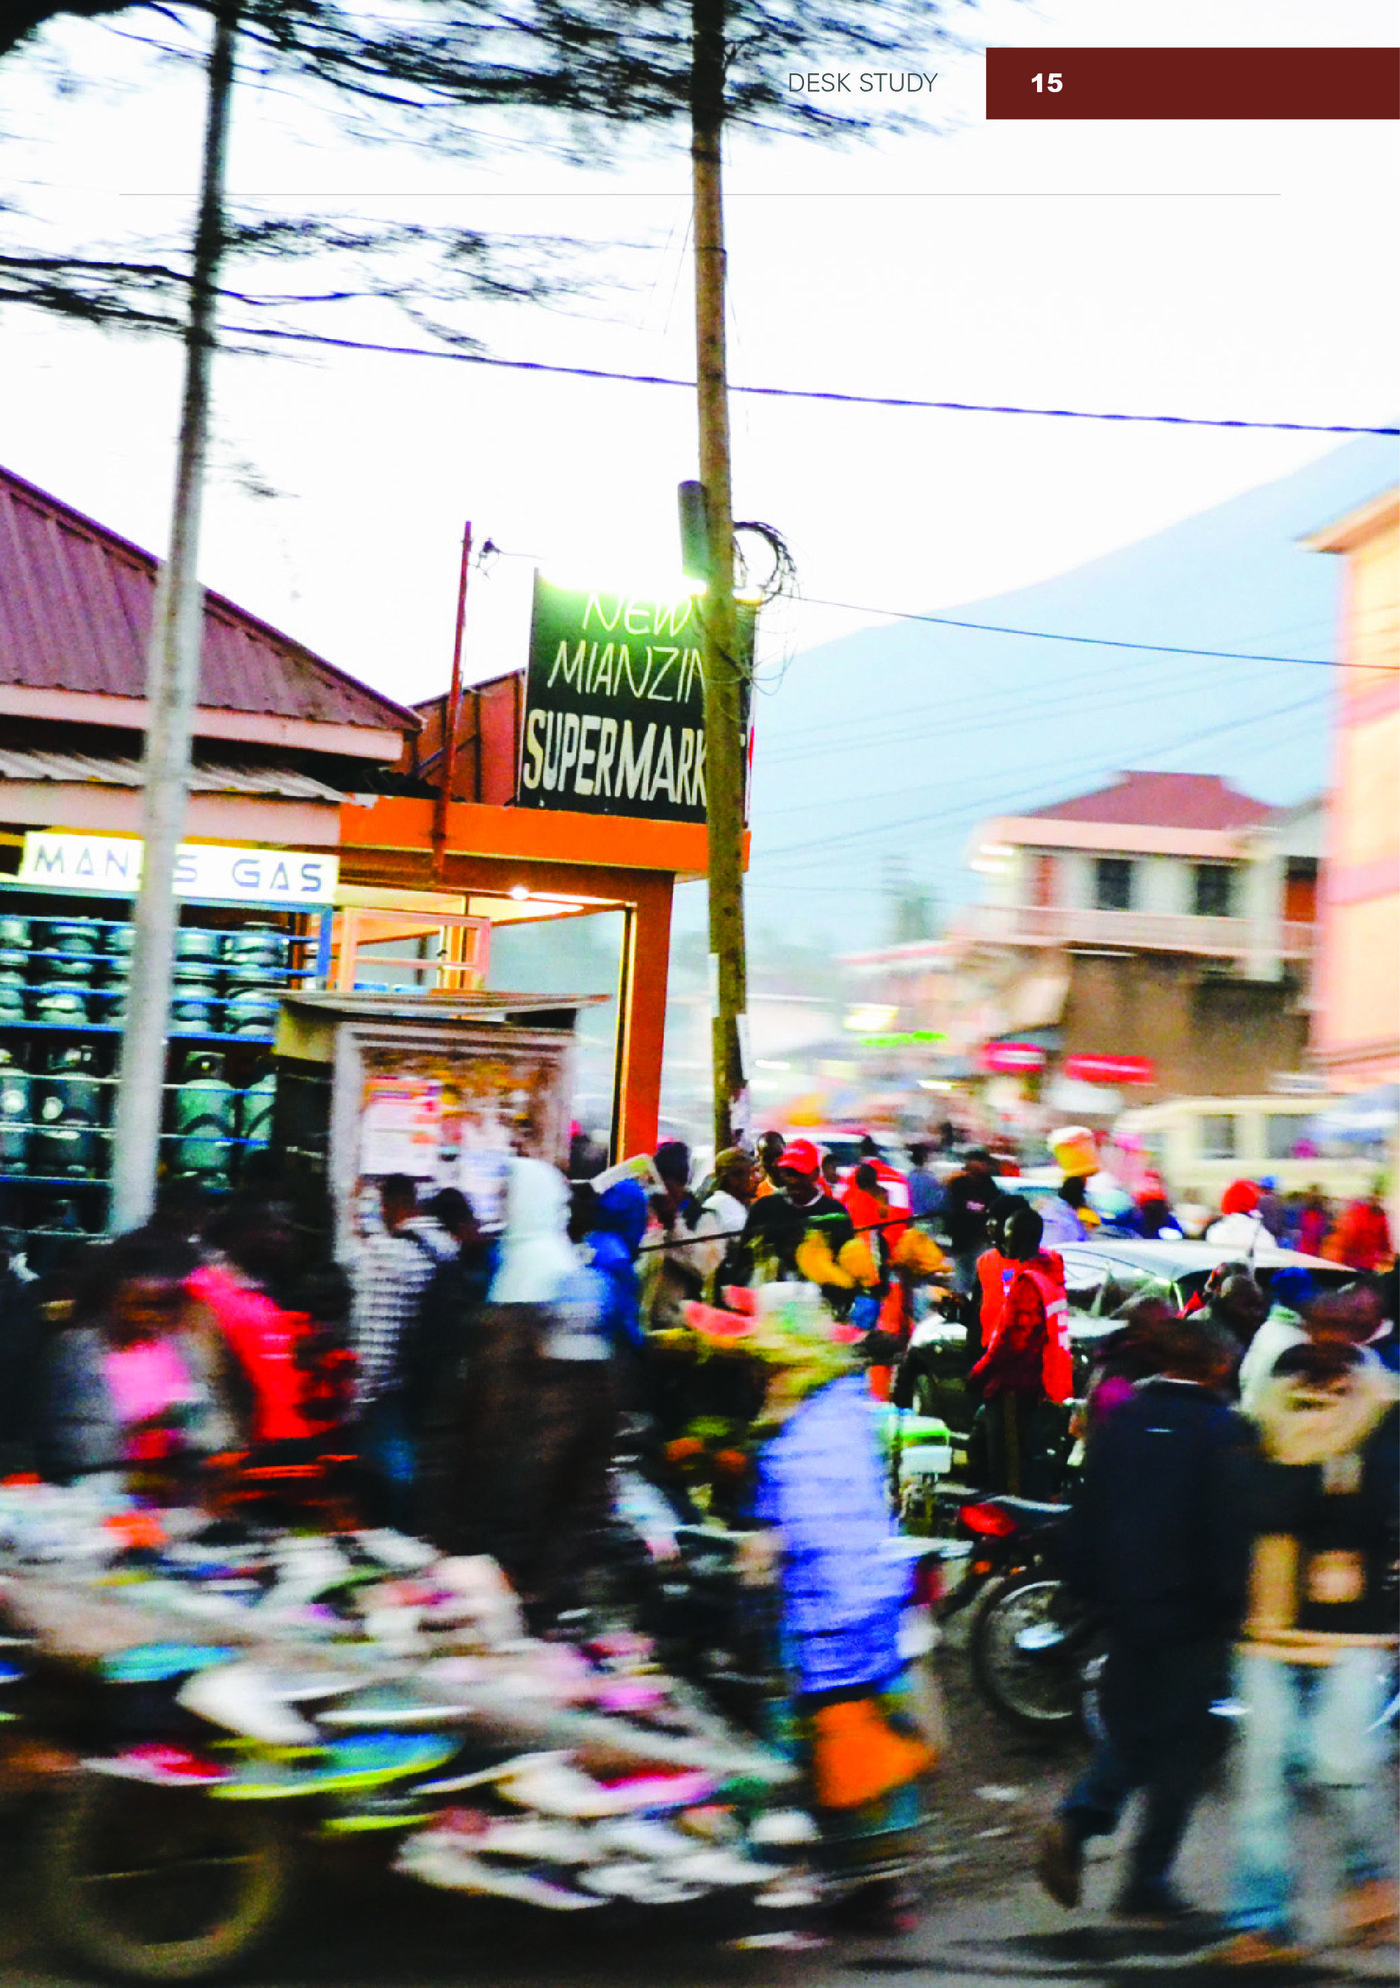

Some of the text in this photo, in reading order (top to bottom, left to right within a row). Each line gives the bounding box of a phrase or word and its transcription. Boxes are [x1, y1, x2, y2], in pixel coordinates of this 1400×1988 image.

[582, 592, 693, 637] NEW
[522, 709, 746, 807] SUPERMARK
[232, 858, 323, 892] GAS
